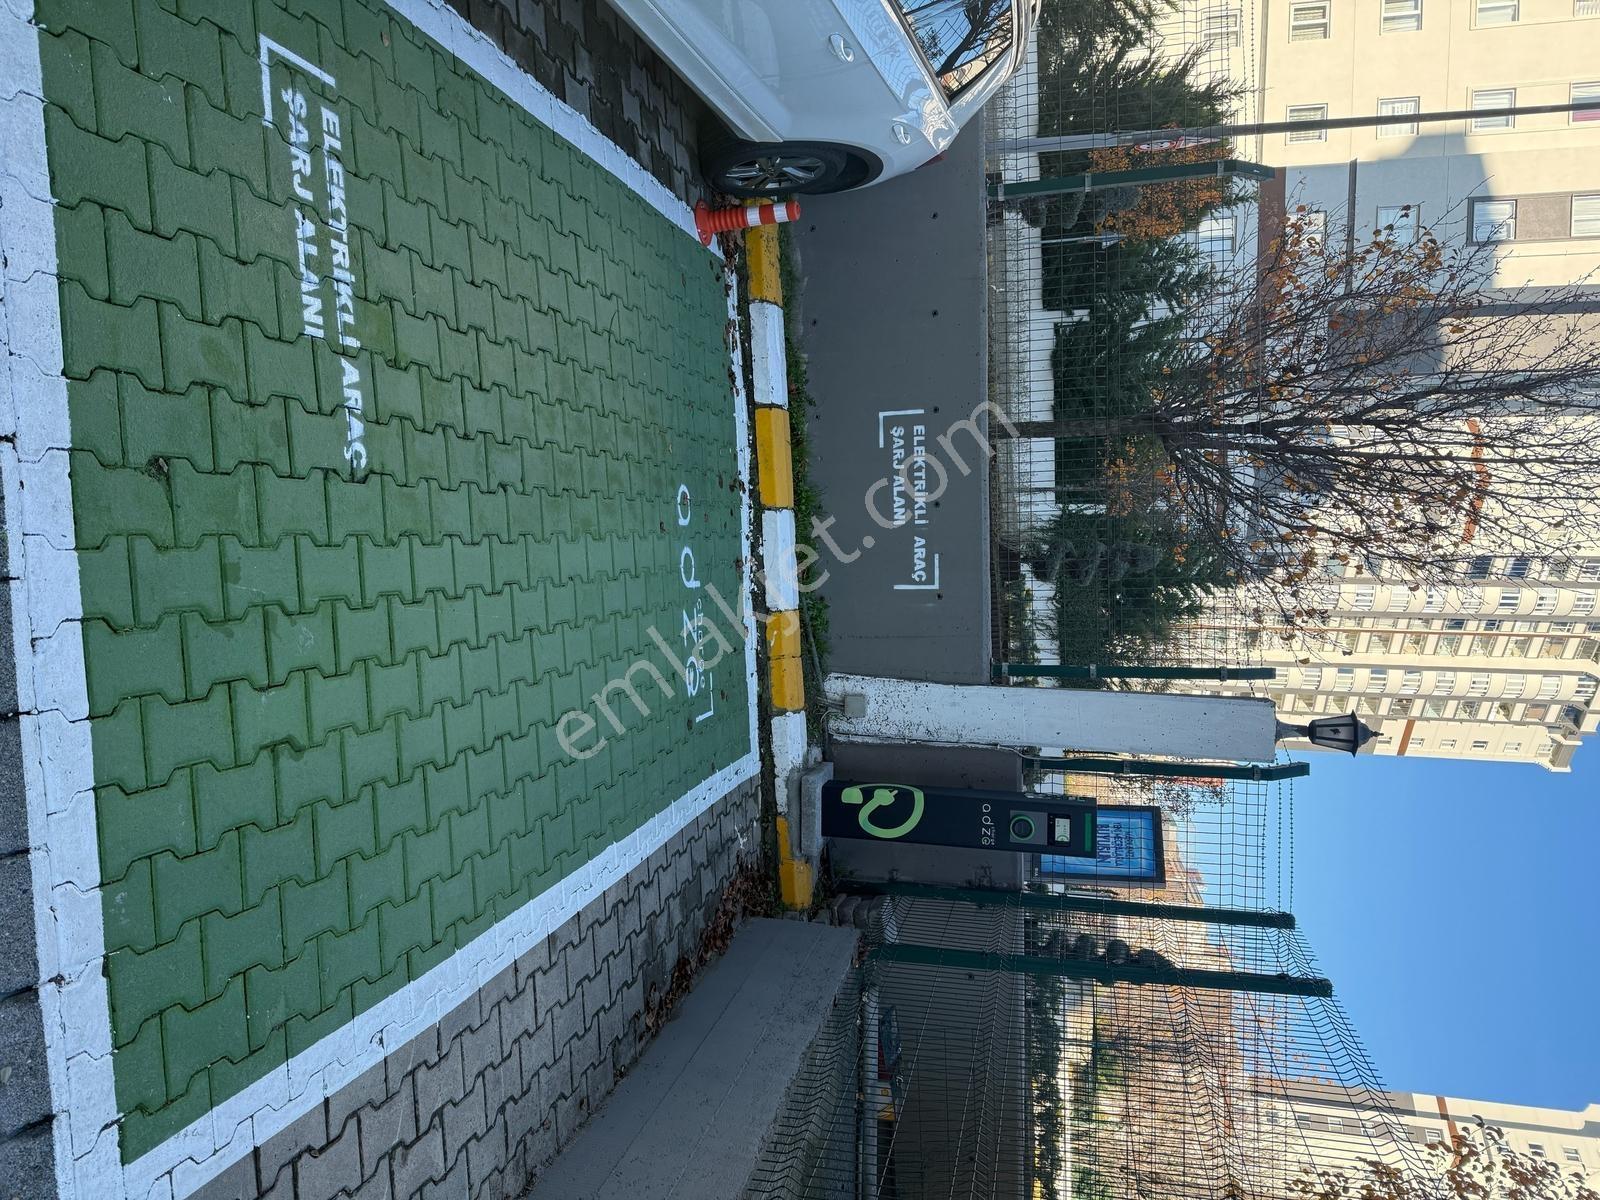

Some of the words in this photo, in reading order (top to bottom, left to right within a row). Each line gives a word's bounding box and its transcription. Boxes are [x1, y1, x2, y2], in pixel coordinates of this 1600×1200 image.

[282, 88, 314, 201] ŞARJ
[294, 208, 325, 338] ALANI
[320, 107, 362, 348] ELEKTRİKLİ
[341, 356, 367, 470] ARAÇ
[889, 426, 905, 470] ŞARJ
[913, 425, 929, 524] ELEKTRİKLİ
[893, 475, 906, 525] ALANI
[911, 536, 927, 582] ARAÇ
[981, 803, 995, 846] adze
